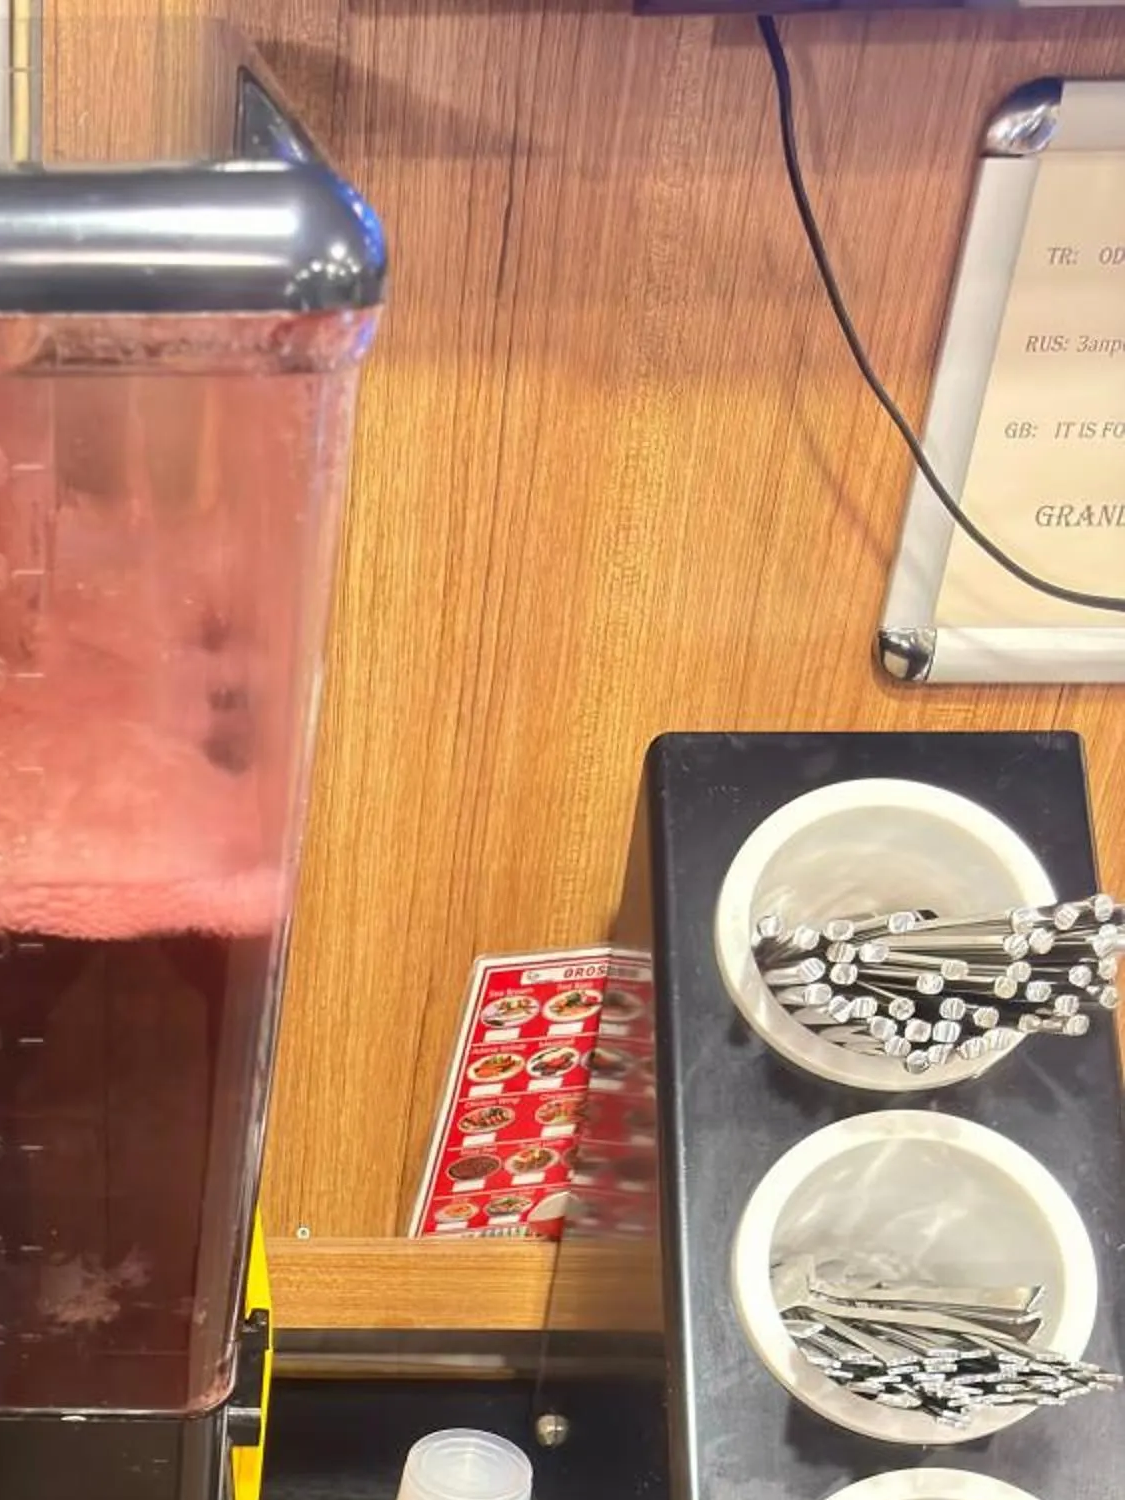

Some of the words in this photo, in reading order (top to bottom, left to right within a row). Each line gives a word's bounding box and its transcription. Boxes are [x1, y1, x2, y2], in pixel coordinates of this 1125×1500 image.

[1047, 246, 1078, 266] TR:
[1025, 335, 1069, 353] RUS:
[1004, 421, 1038, 439] GB:
